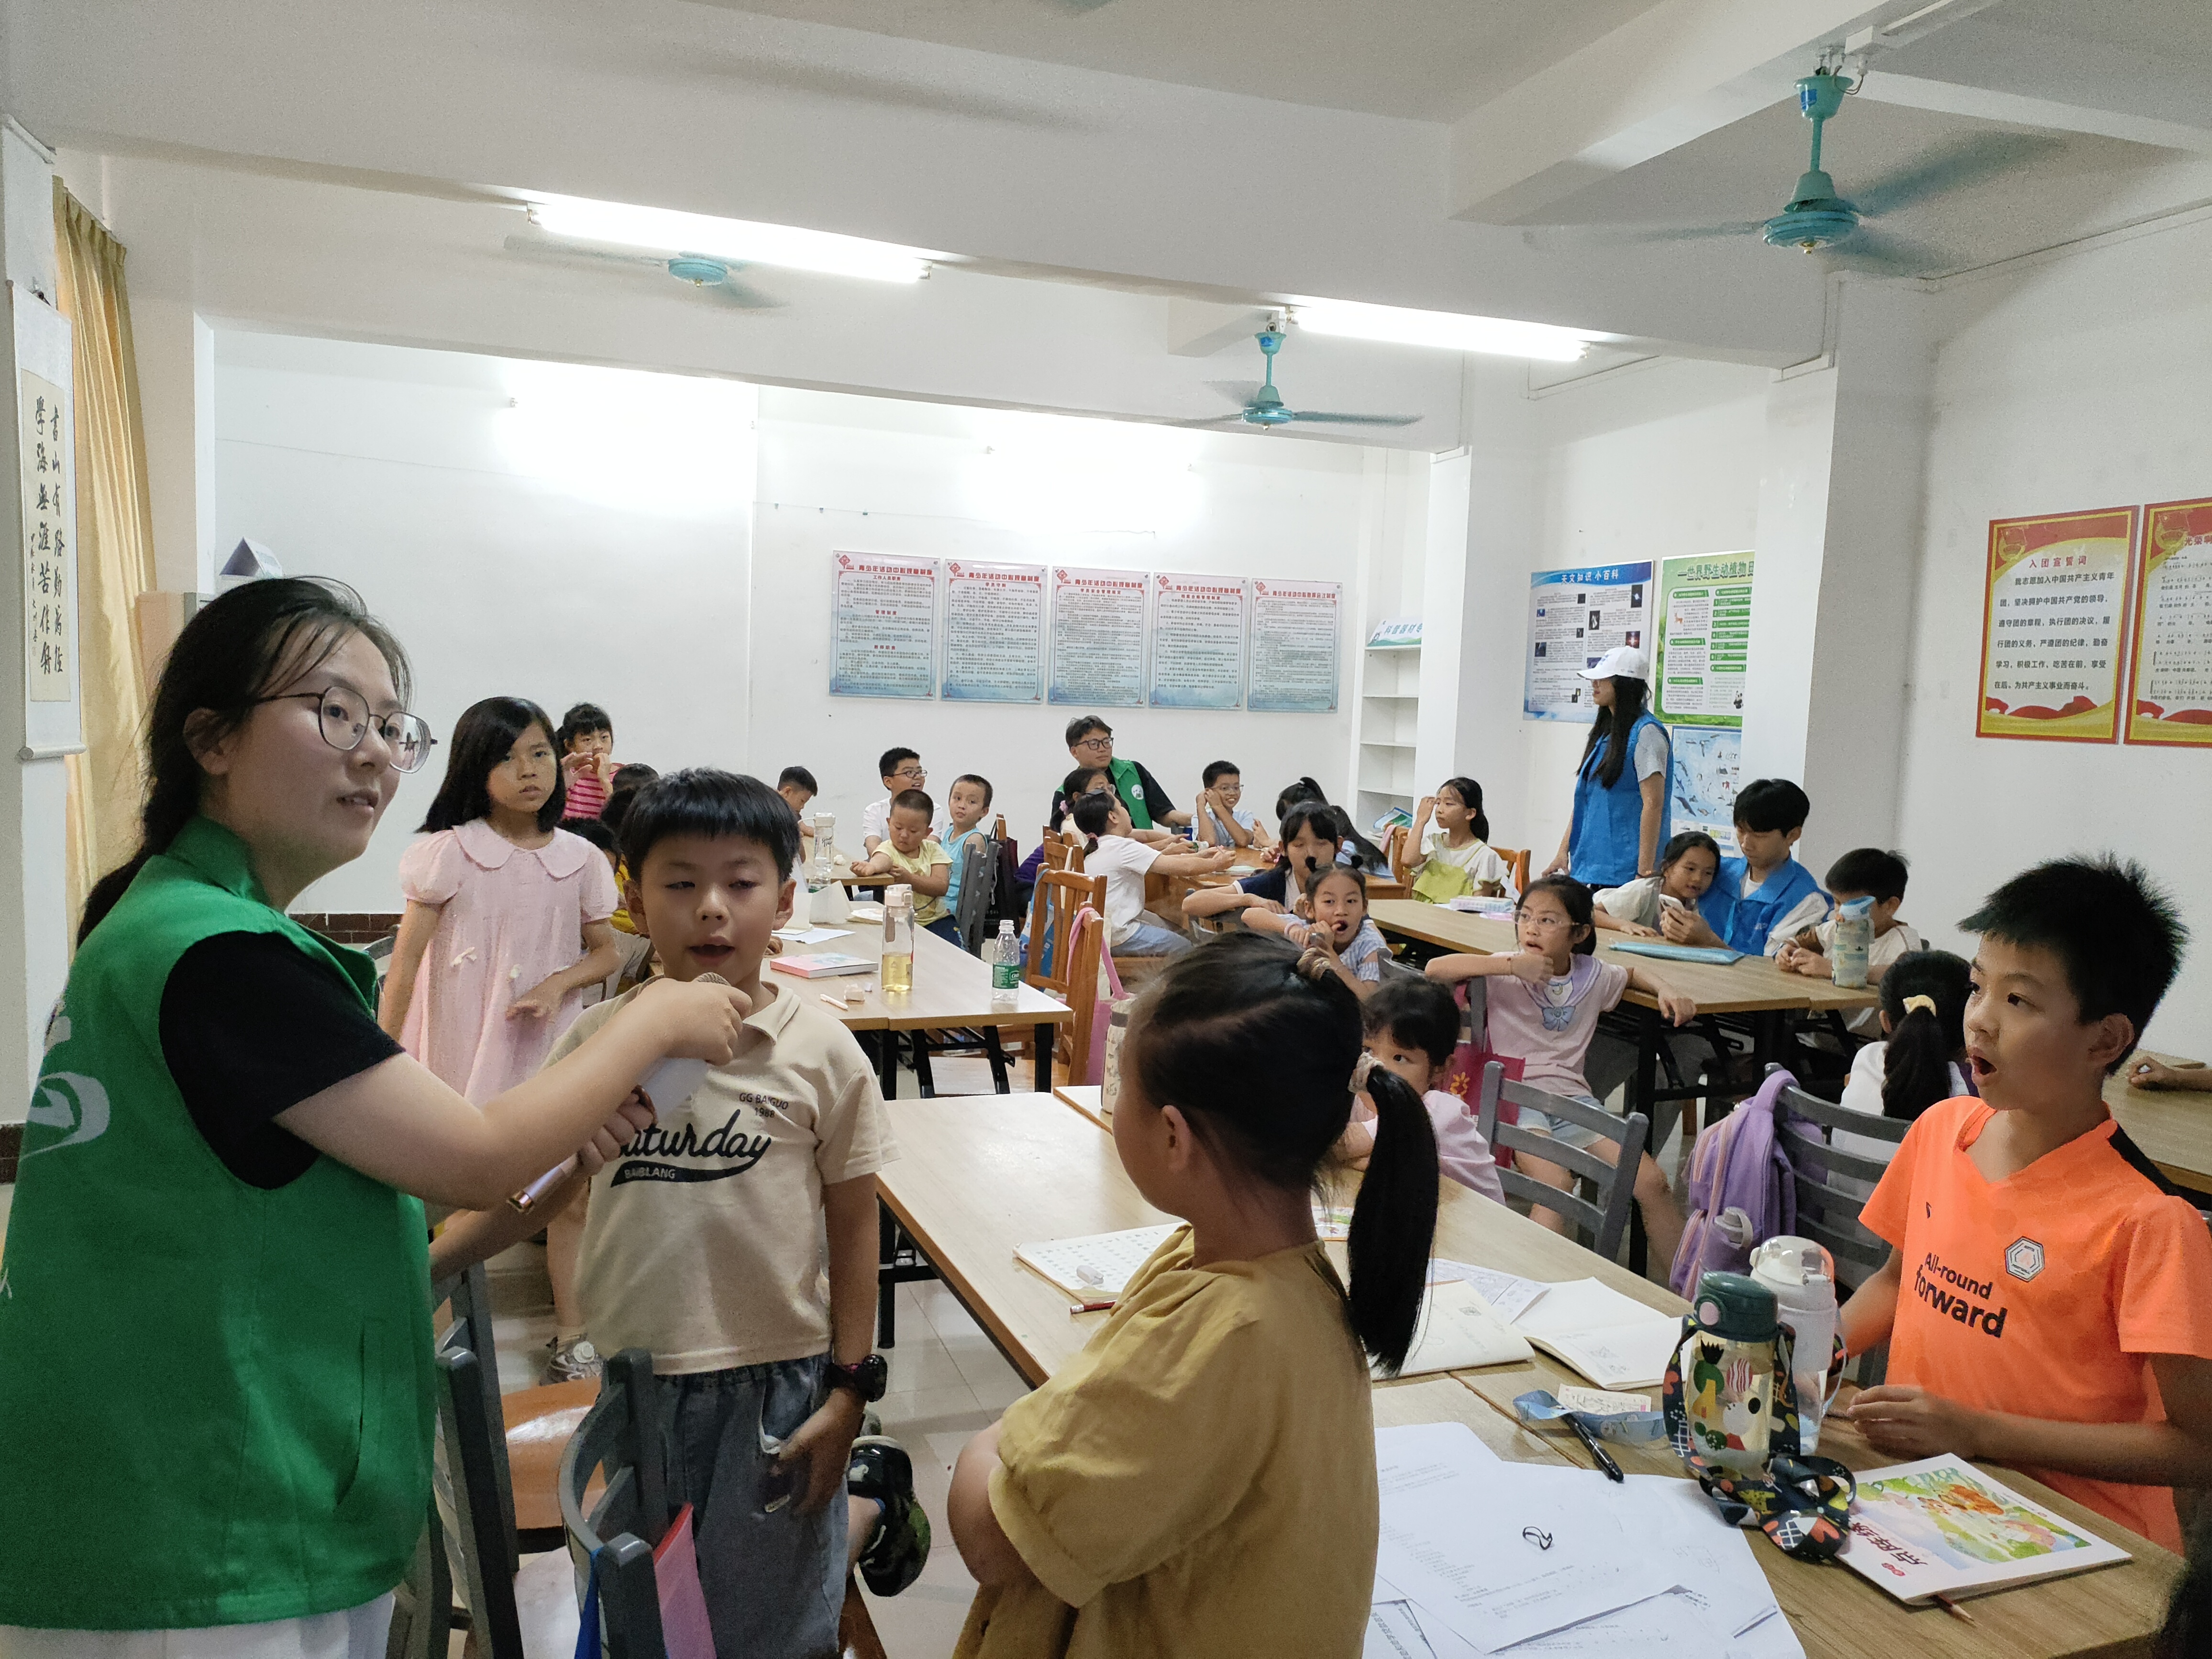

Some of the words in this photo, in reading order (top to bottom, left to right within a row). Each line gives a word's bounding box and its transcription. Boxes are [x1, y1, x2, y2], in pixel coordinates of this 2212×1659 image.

[2029, 555, 2087, 568] 入团宣誓词
[859, 565, 933, 575] 青少年活动中心规章制度
[1561, 568, 1619, 585] 天文知识小百科
[969, 573, 1040, 582] 青少年活动中心规章制度
[1075, 579, 1143, 588] 青少年活动中心规章制度
[2015, 572, 2114, 586] 我志愿加入中国共产主义青年
[739, 1093, 753, 1103] GG
[620, 1109, 772, 1160] aturday
[1924, 1252, 1993, 1300] All-round
[1914, 1264, 2008, 1338] forward
